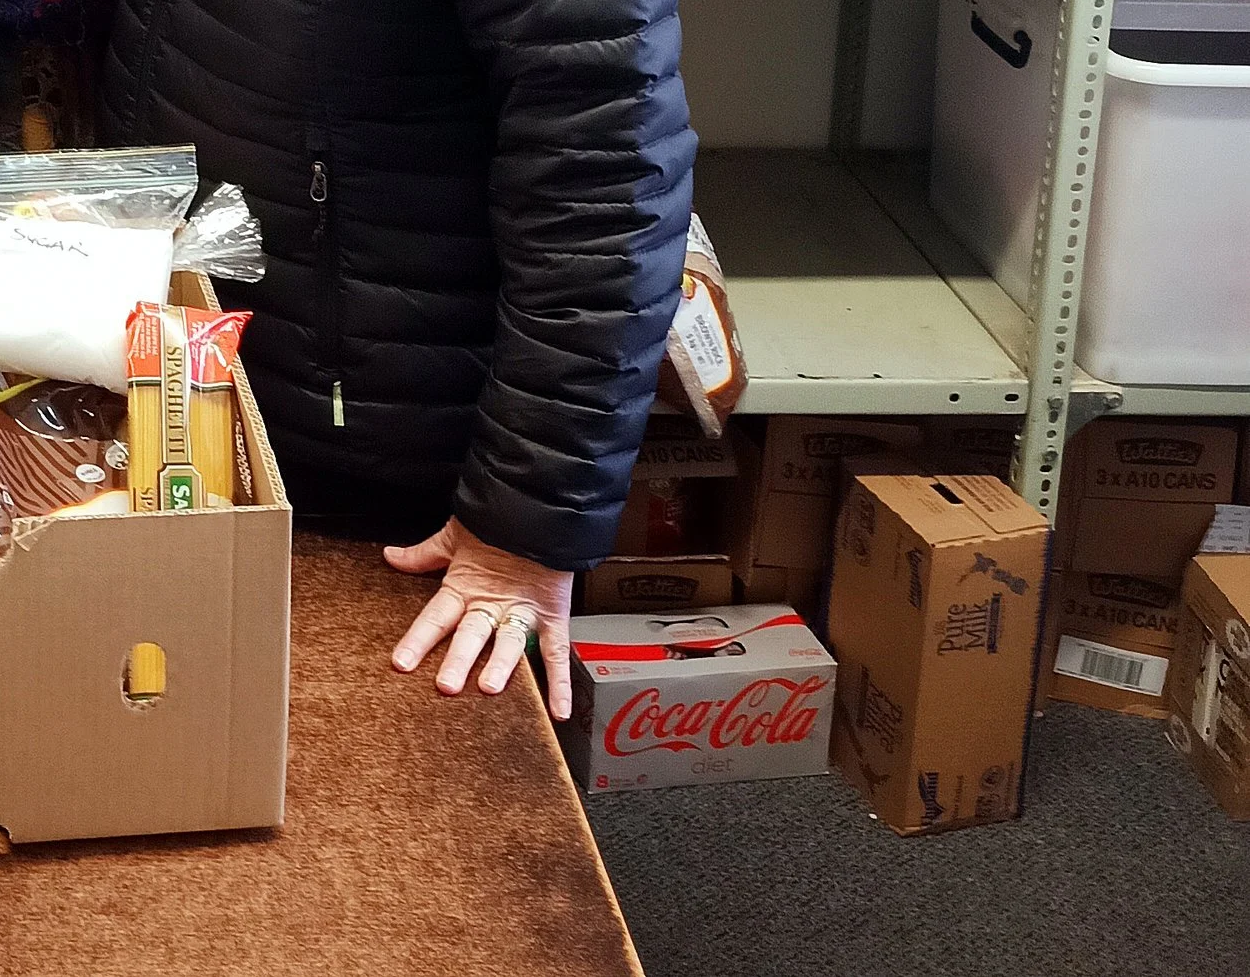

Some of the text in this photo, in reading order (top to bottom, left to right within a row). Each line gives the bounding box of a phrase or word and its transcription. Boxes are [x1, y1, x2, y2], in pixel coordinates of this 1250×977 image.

[166, 345, 185, 455] SPAGHETTI
[673, 446, 724, 463] CANS
[1124, 473, 1160, 488] A10
[1164, 473, 1216, 490] CANS
[172, 484, 190, 509] SA
[937, 603, 967, 656] Pure
[964, 599, 990, 652] Milk
[596, 666, 610, 676] 8
[604, 675, 830, 756] Coca-Cola
[691, 757, 733, 774] diet
[595, 775, 609, 788] 8
